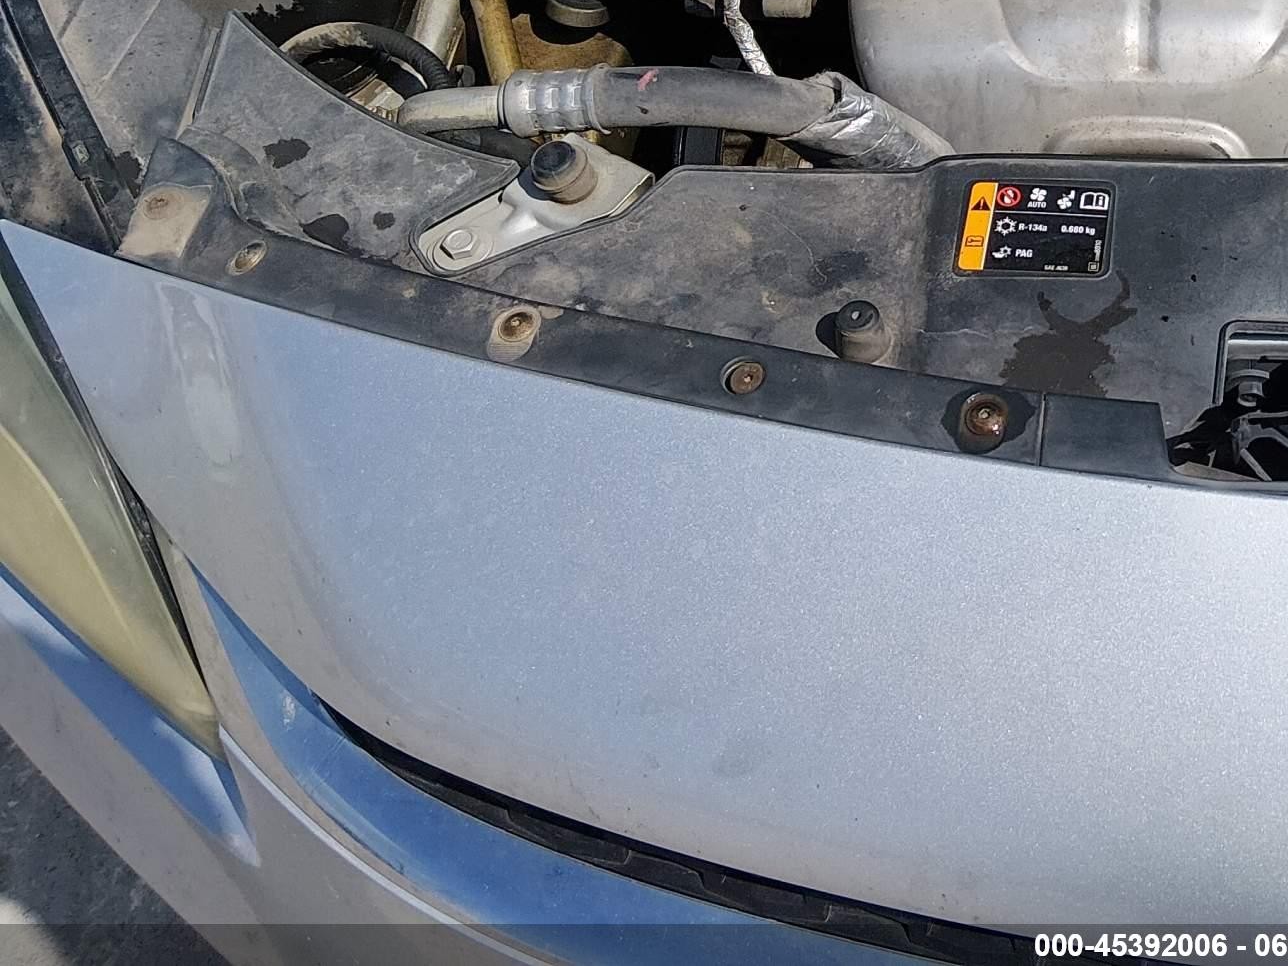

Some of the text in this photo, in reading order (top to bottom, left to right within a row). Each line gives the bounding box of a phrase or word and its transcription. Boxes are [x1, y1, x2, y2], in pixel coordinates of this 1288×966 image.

[1018, 223, 1048, 232] R-134a
[1085, 226, 1096, 236] kg
[1015, 249, 1033, 258] PAG
